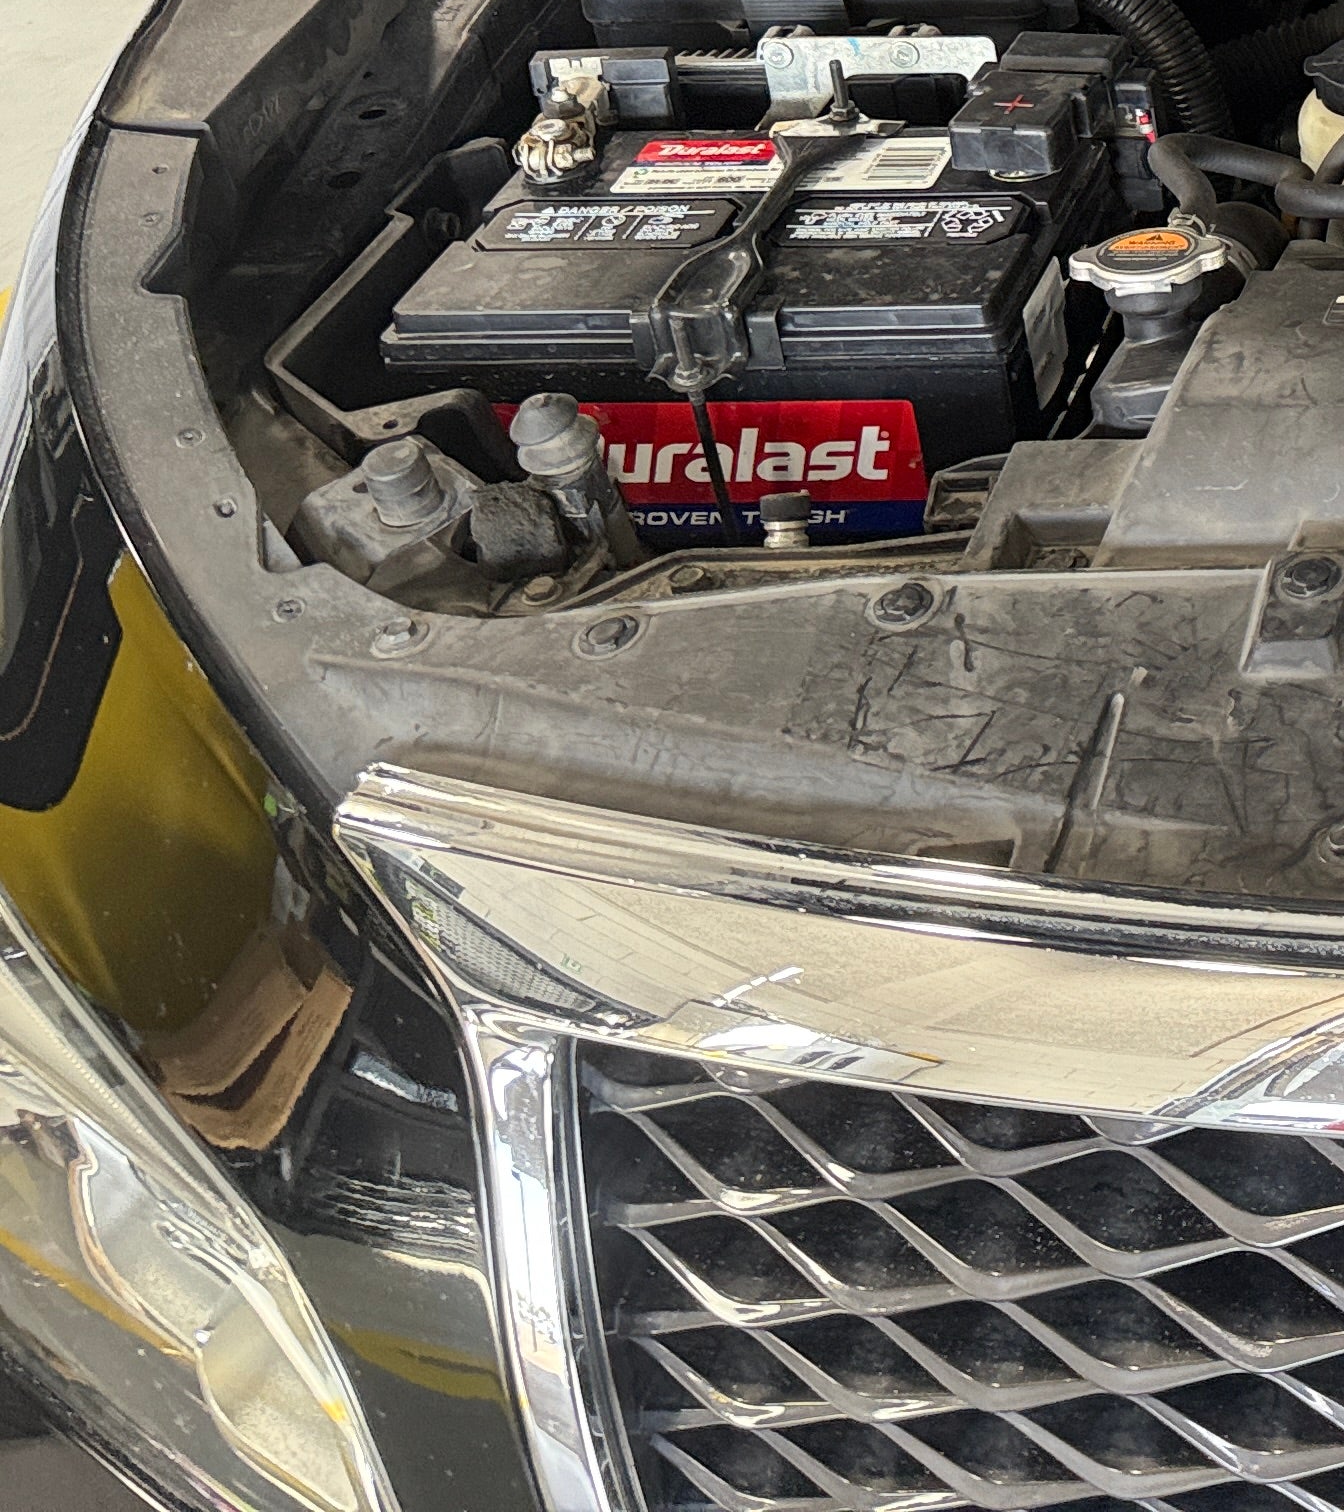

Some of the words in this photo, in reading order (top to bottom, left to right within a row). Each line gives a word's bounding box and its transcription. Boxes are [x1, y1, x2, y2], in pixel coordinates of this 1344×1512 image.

[658, 143, 766, 156] Duralast
[557, 205, 621, 215] DANGER
[632, 204, 691, 214] POISON
[602, 425, 891, 484] uralast
[630, 510, 724, 527] ROVEN
[742, 509, 847, 525] TGH
